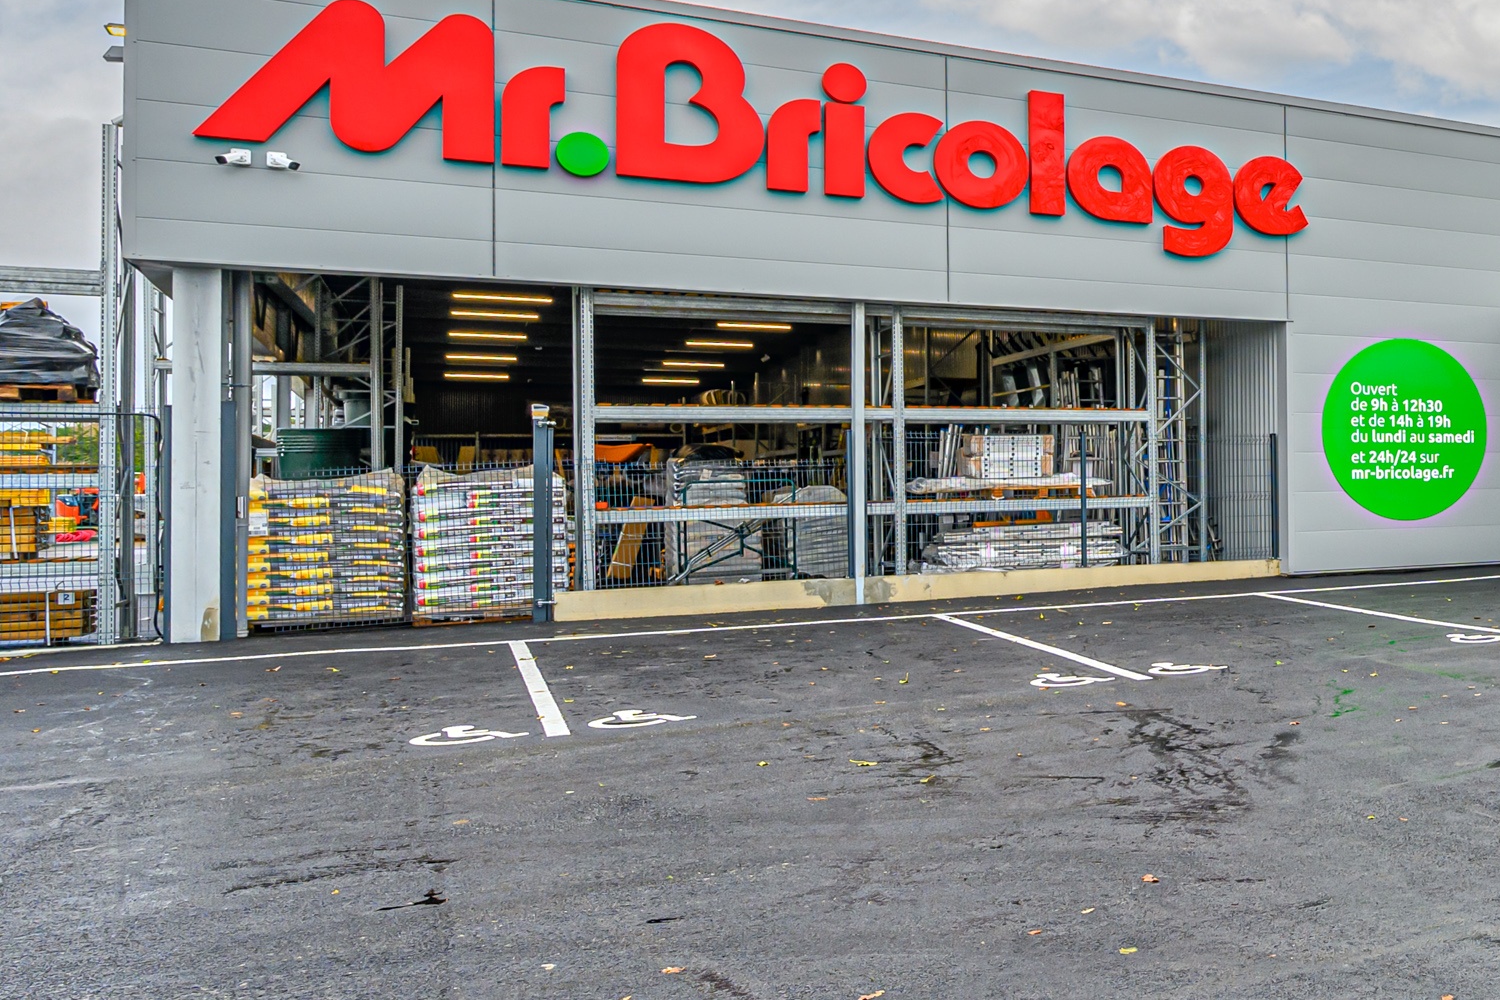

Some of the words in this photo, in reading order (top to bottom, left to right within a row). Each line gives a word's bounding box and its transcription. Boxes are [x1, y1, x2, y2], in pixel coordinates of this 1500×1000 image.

[1350, 381, 1398, 396] Ouvert
[1350, 397, 1368, 411] de
[1370, 398, 1389, 412] 9h
[1391, 398, 1399, 412] à
[1402, 399, 1443, 413] 12h30
[1350, 415, 1366, 427] et
[1368, 413, 1386, 427] de
[1389, 414, 1414, 428] 14h
[1416, 414, 1424, 428] à
[1427, 415, 1452, 428] 19h
[1350, 429, 1369, 443] du
[1371, 429, 1407, 443] lundi
[1409, 432, 1425, 443] au
[1428, 430, 1475, 444] samedi
[1351, 452, 1367, 464] et
[1368, 450, 1417, 466] 24h/24
[1419, 453, 1440, 464] sur
[1351, 465, 1455, 482] mr-bricolage.fr
[63, 593, 70, 601] 2
